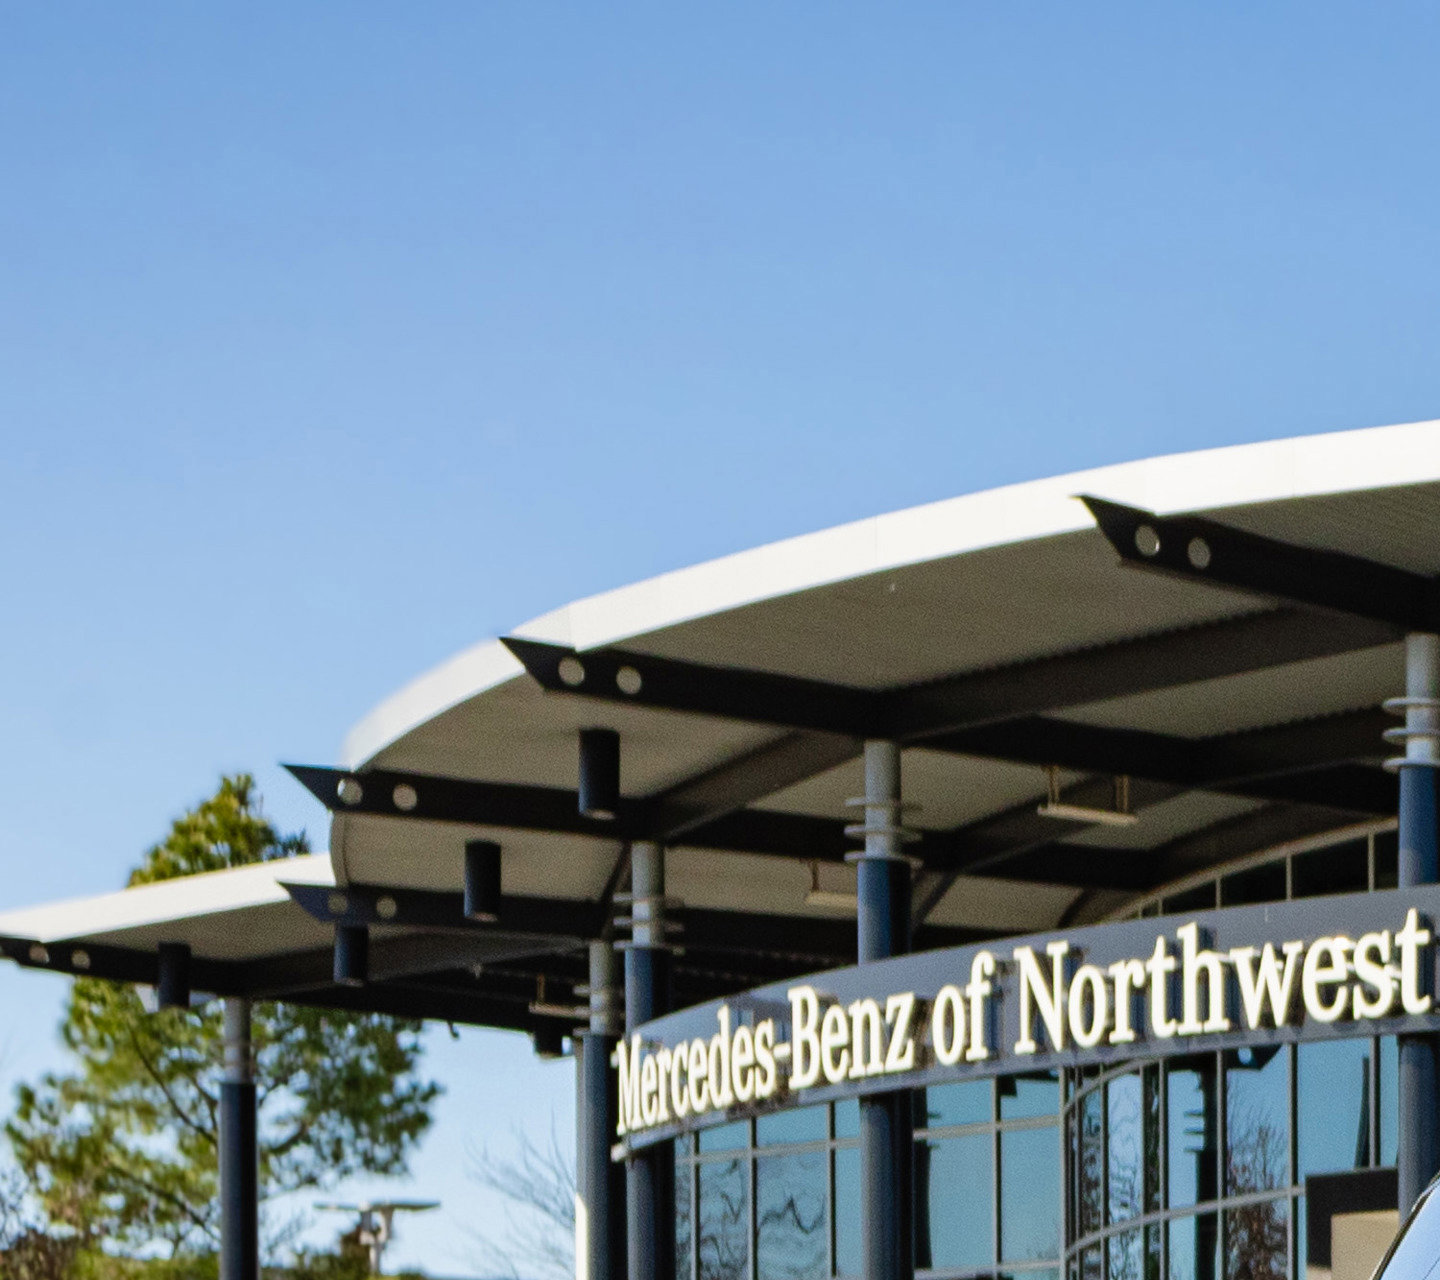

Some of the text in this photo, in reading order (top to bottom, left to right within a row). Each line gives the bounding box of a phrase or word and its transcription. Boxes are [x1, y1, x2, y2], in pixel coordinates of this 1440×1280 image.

[616, 985, 915, 1135] Mercedes-Benz
[932, 951, 995, 1066] of
[1013, 907, 1431, 1054] Northwest
